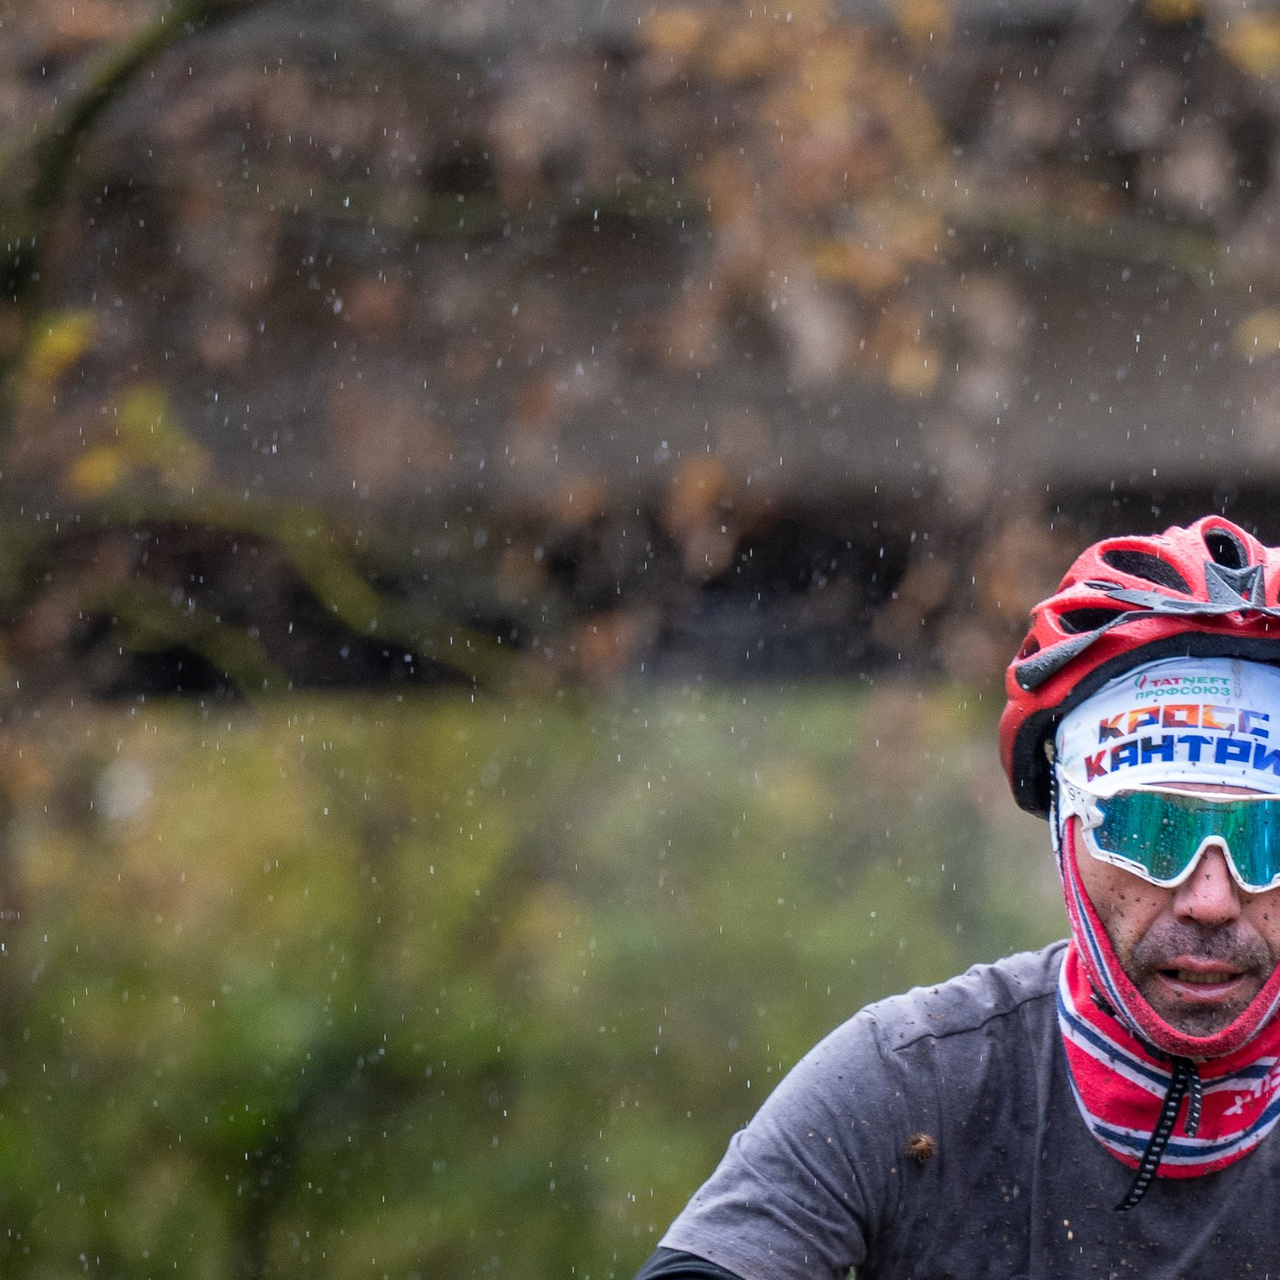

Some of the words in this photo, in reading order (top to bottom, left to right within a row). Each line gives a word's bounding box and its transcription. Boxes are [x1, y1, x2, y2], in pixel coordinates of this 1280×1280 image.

[1150, 676, 1230, 687] TATNEFT
[1135, 686, 1231, 700] ПРОФСОЮЗ
[1098, 704, 1270, 744] КРОСС
